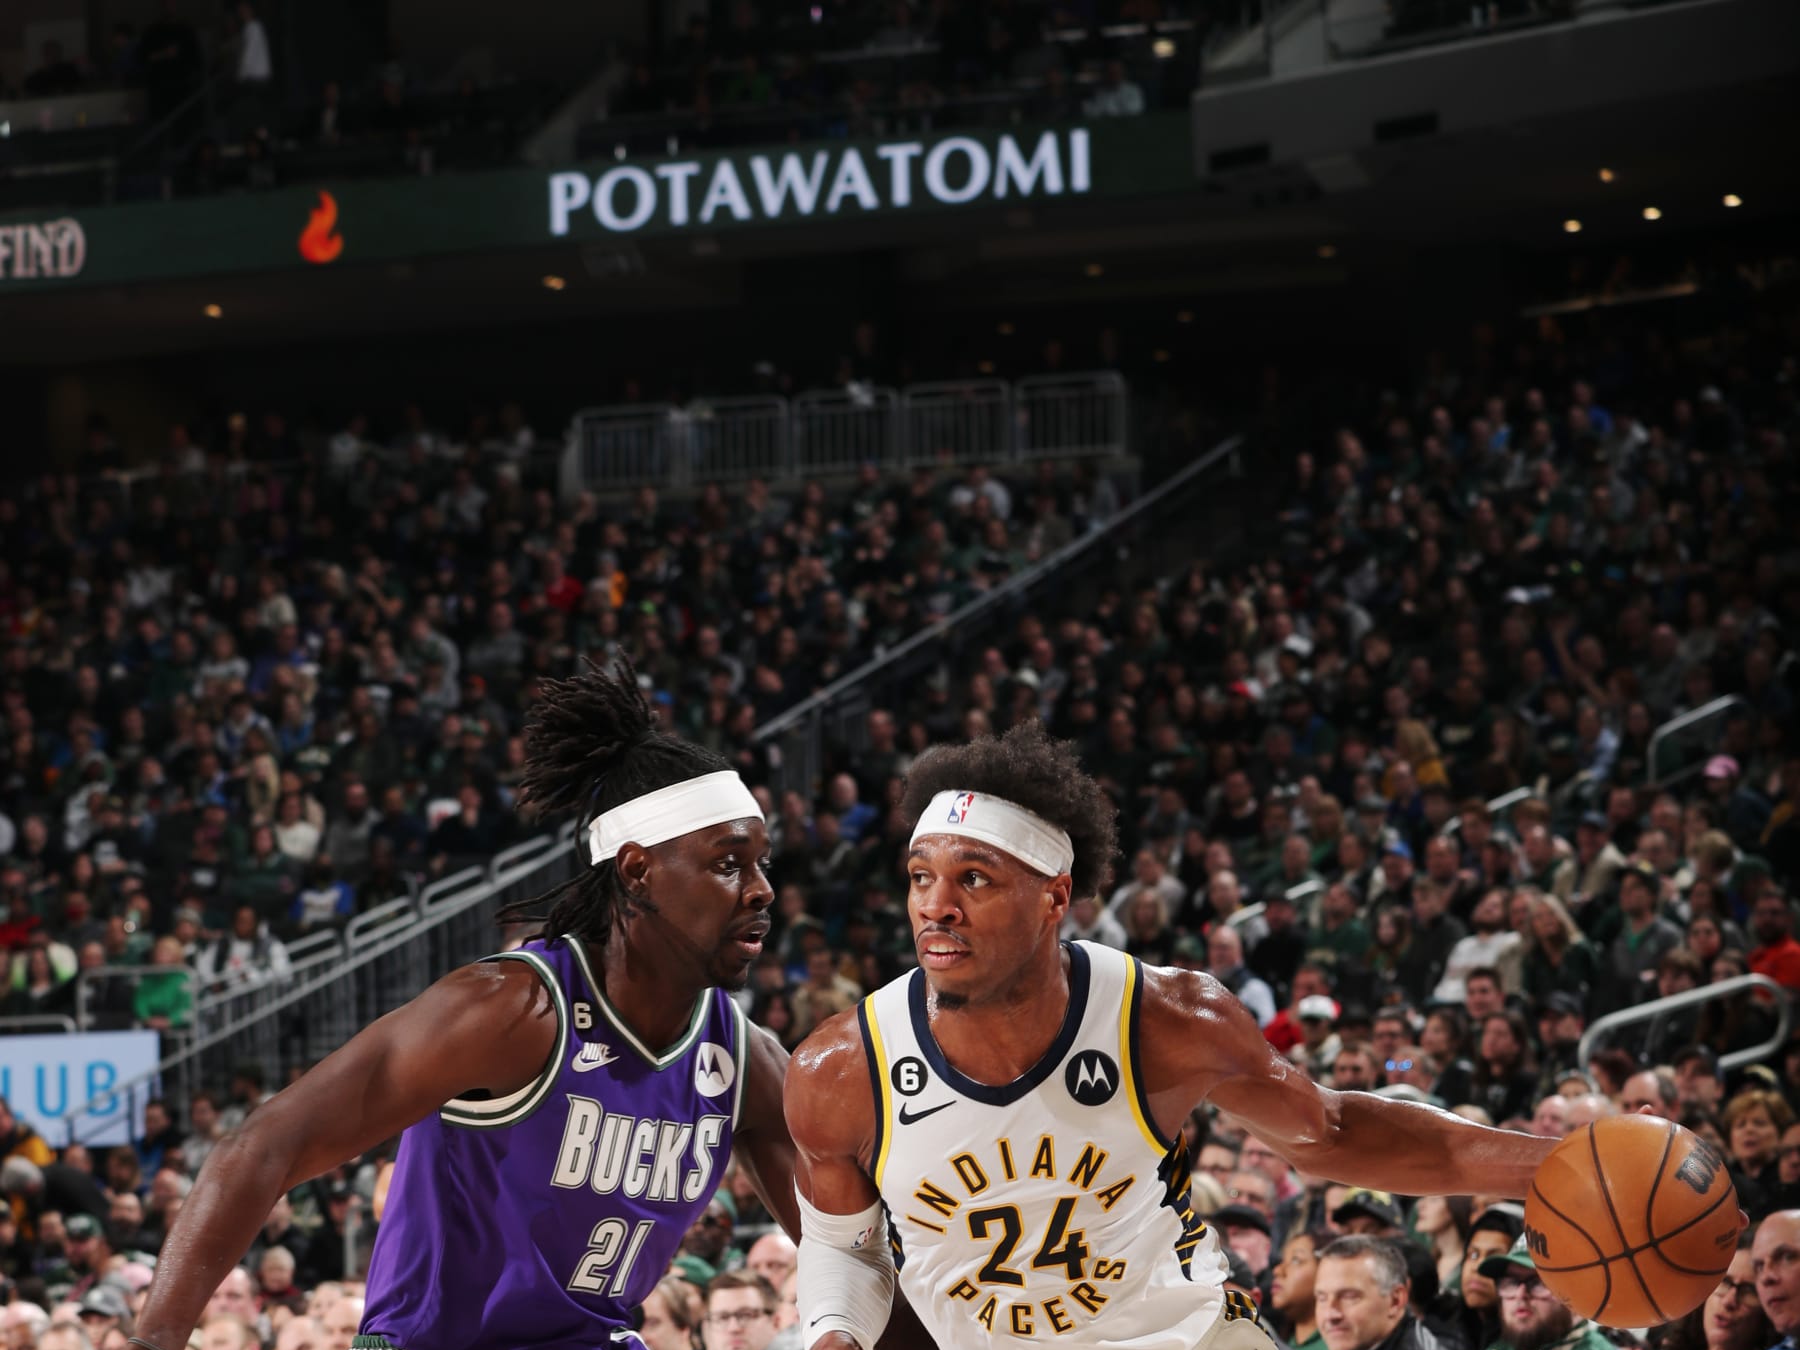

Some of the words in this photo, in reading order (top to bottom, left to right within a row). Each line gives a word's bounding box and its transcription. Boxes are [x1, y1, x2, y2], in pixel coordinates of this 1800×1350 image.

[548, 128, 1090, 236] POTAWATOMI
[574, 1002, 592, 1029] 6
[581, 1042, 610, 1061] NIKE
[900, 1062, 919, 1091] 6
[551, 1094, 731, 1201] BUCKS
[907, 1135, 1135, 1234] INDIANA
[566, 1217, 656, 1298] 21
[967, 1196, 1091, 1288] 24
[947, 1258, 1128, 1336] PACERS
